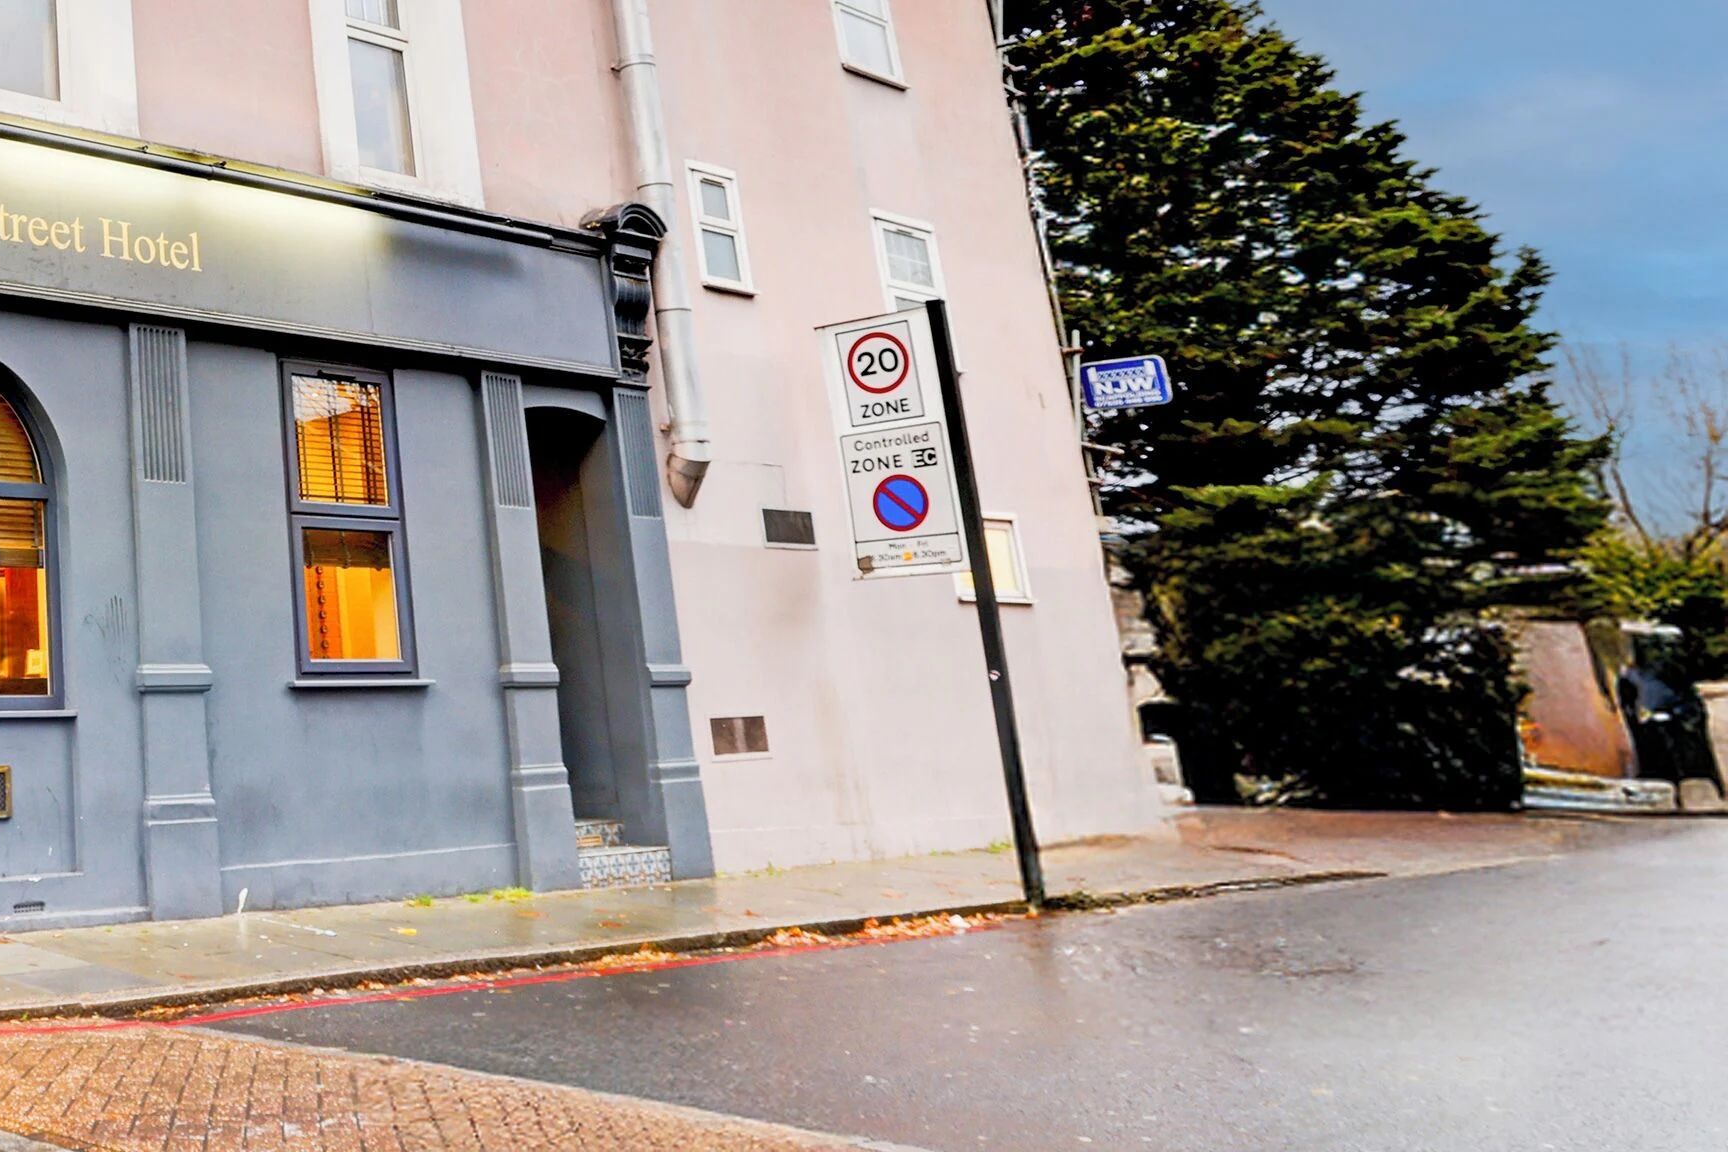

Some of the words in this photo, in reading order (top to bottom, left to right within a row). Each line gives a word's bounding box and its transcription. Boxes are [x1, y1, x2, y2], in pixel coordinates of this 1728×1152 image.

[98, 217, 203, 273] Hotel
[857, 347, 899, 377] 20
[1093, 376, 1154, 396] NJW
[860, 397, 911, 419] ZONE
[854, 431, 930, 452] Controlled
[851, 454, 904, 474] ZONE
[913, 448, 938, 468] EC
